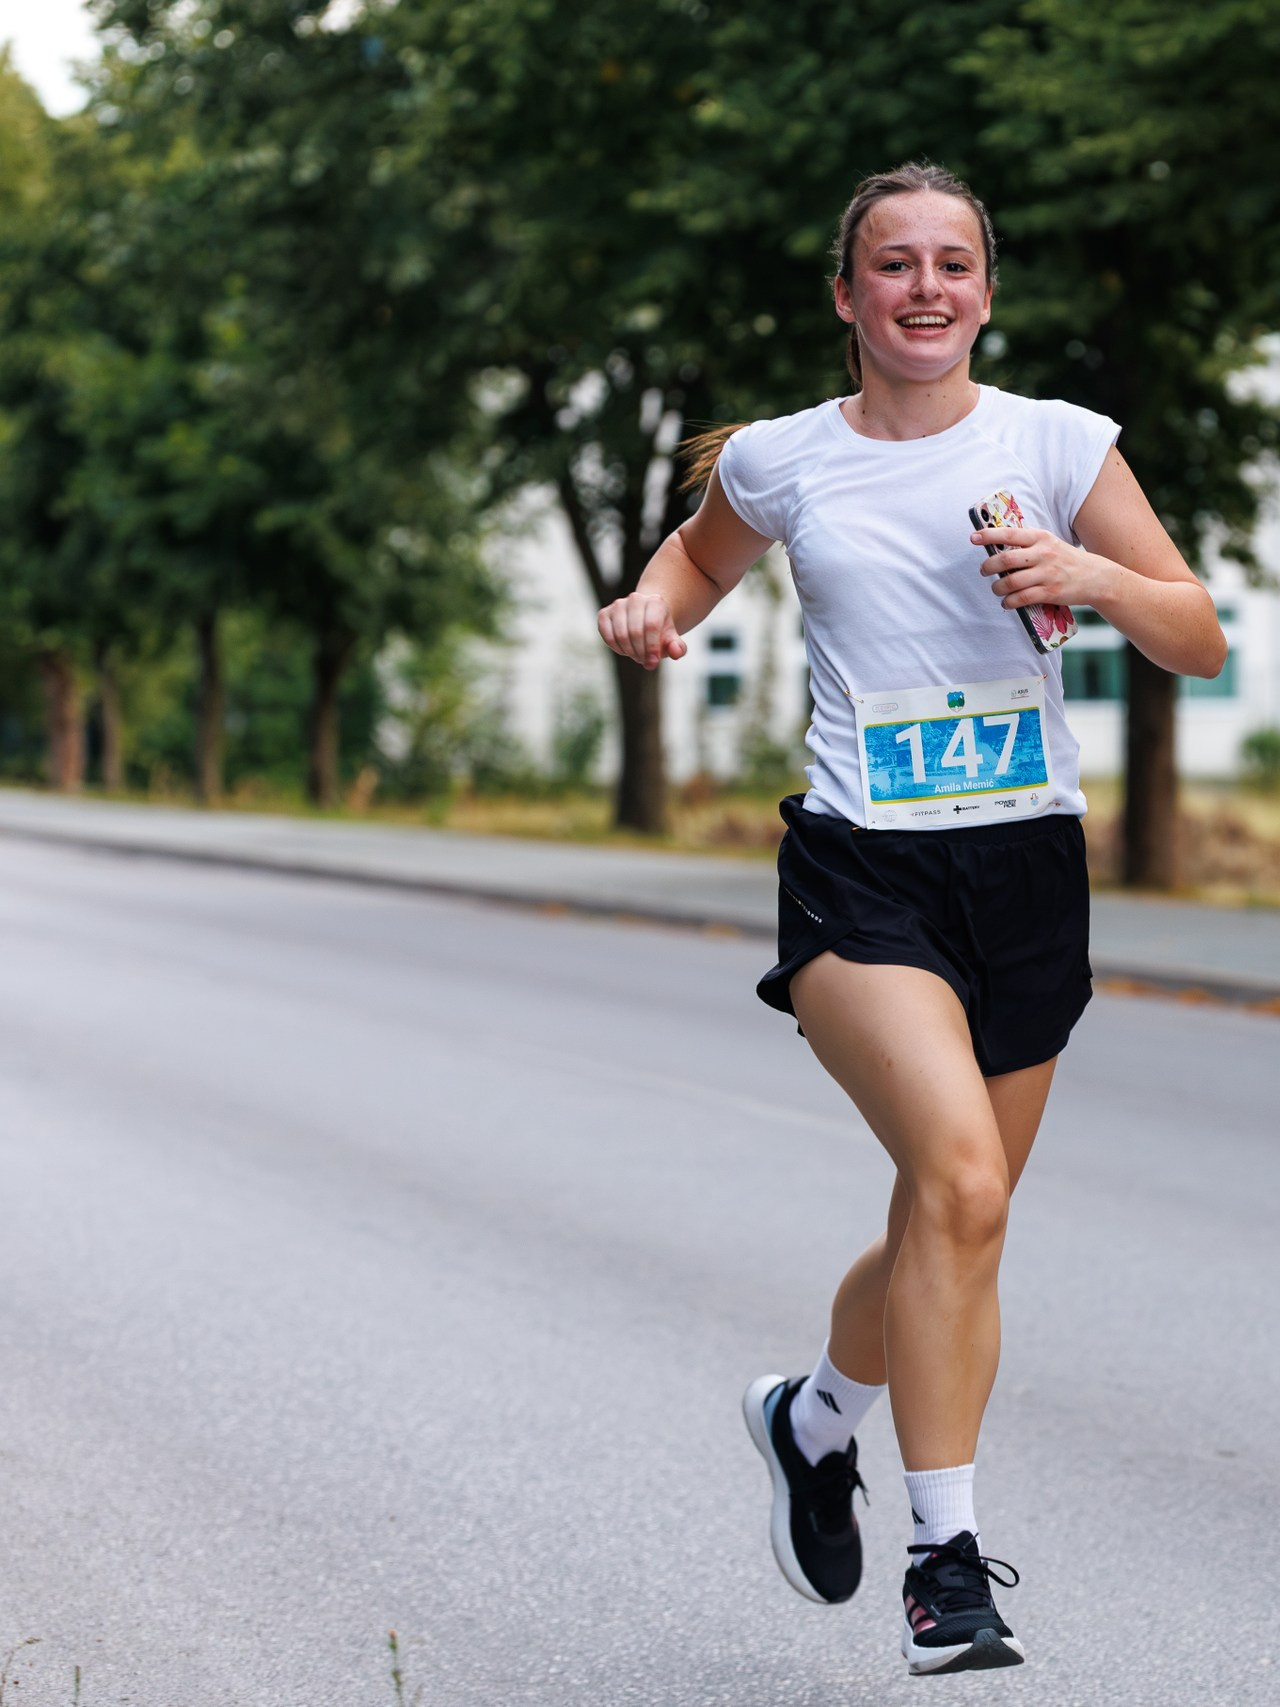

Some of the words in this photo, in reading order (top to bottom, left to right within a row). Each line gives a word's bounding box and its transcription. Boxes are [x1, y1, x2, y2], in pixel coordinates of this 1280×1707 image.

[895, 712, 1020, 784] 147
[934, 782, 961, 793] Amila
[914, 809, 942, 817] FITPASS
